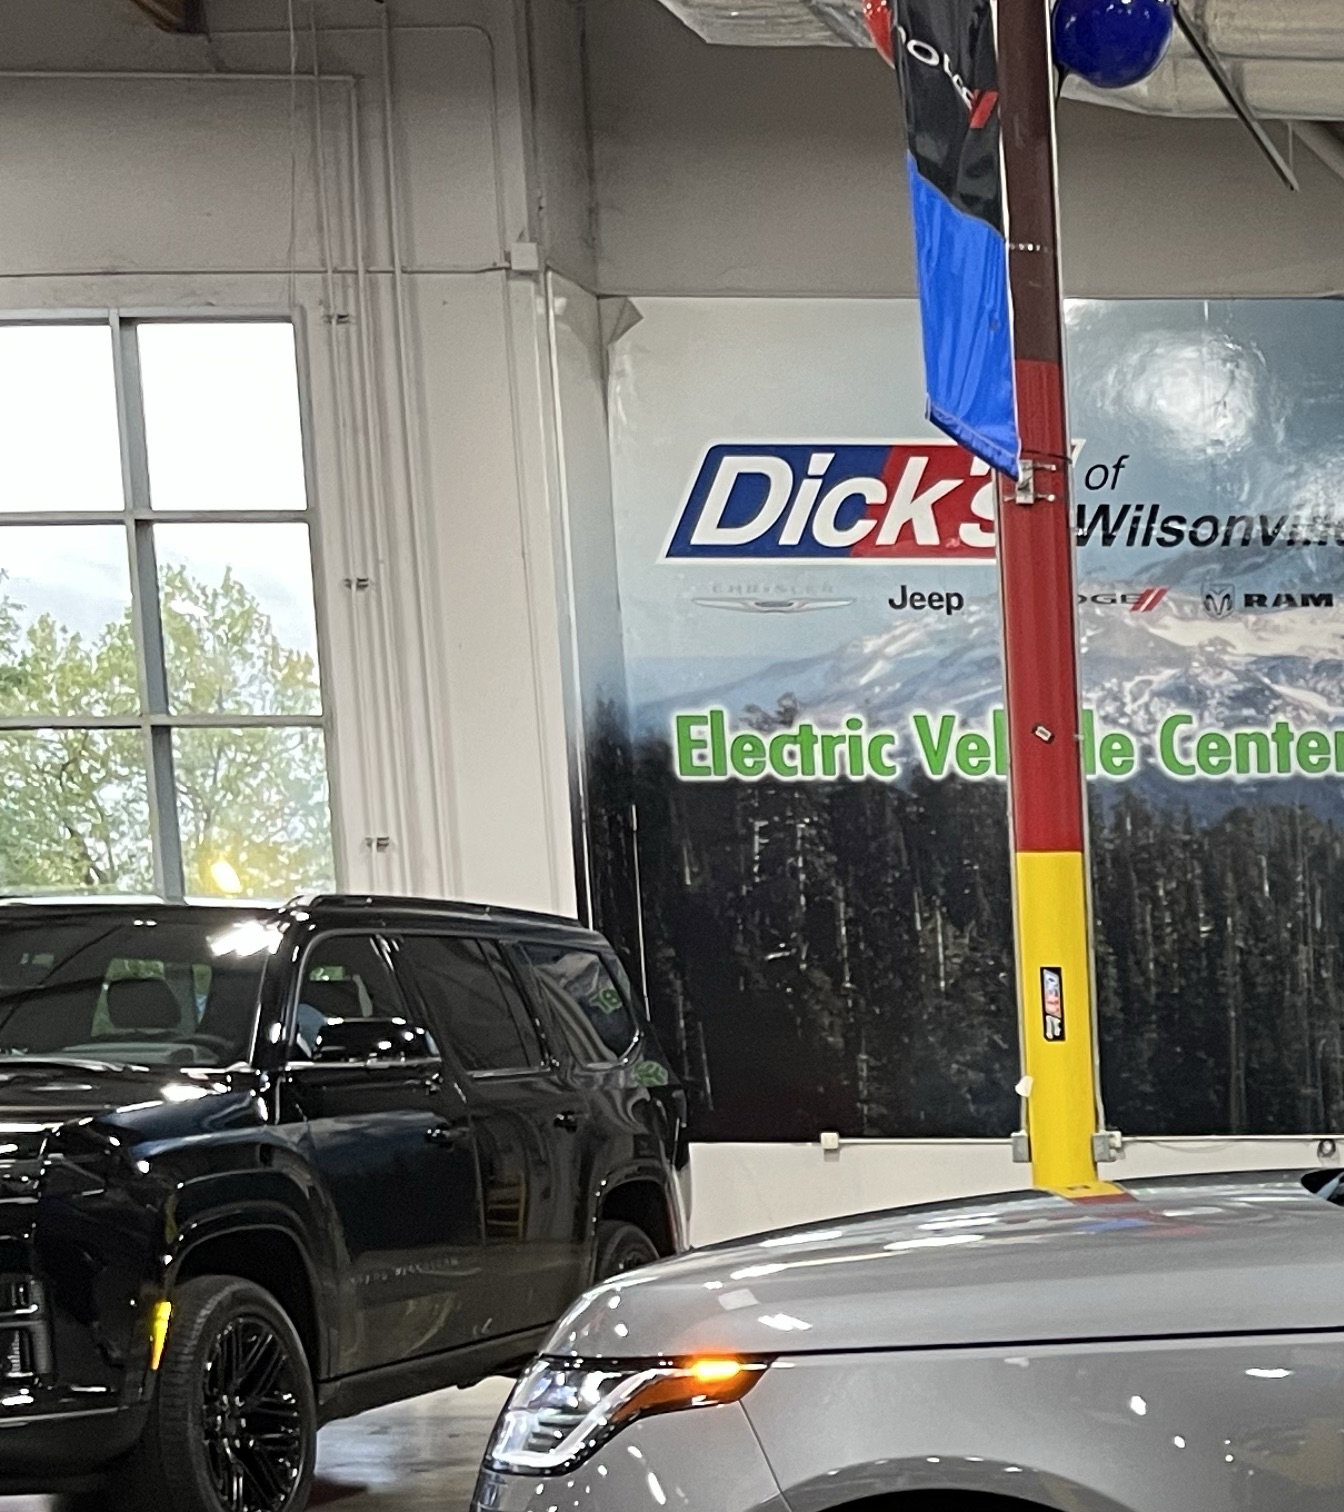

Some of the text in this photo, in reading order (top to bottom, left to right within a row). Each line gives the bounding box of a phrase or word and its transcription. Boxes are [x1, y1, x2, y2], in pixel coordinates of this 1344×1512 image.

[1084, 455, 1130, 491] of
[888, 584, 964, 615] Jeep
[1243, 593, 1334, 608] RAM
[675, 709, 897, 776] Electric
